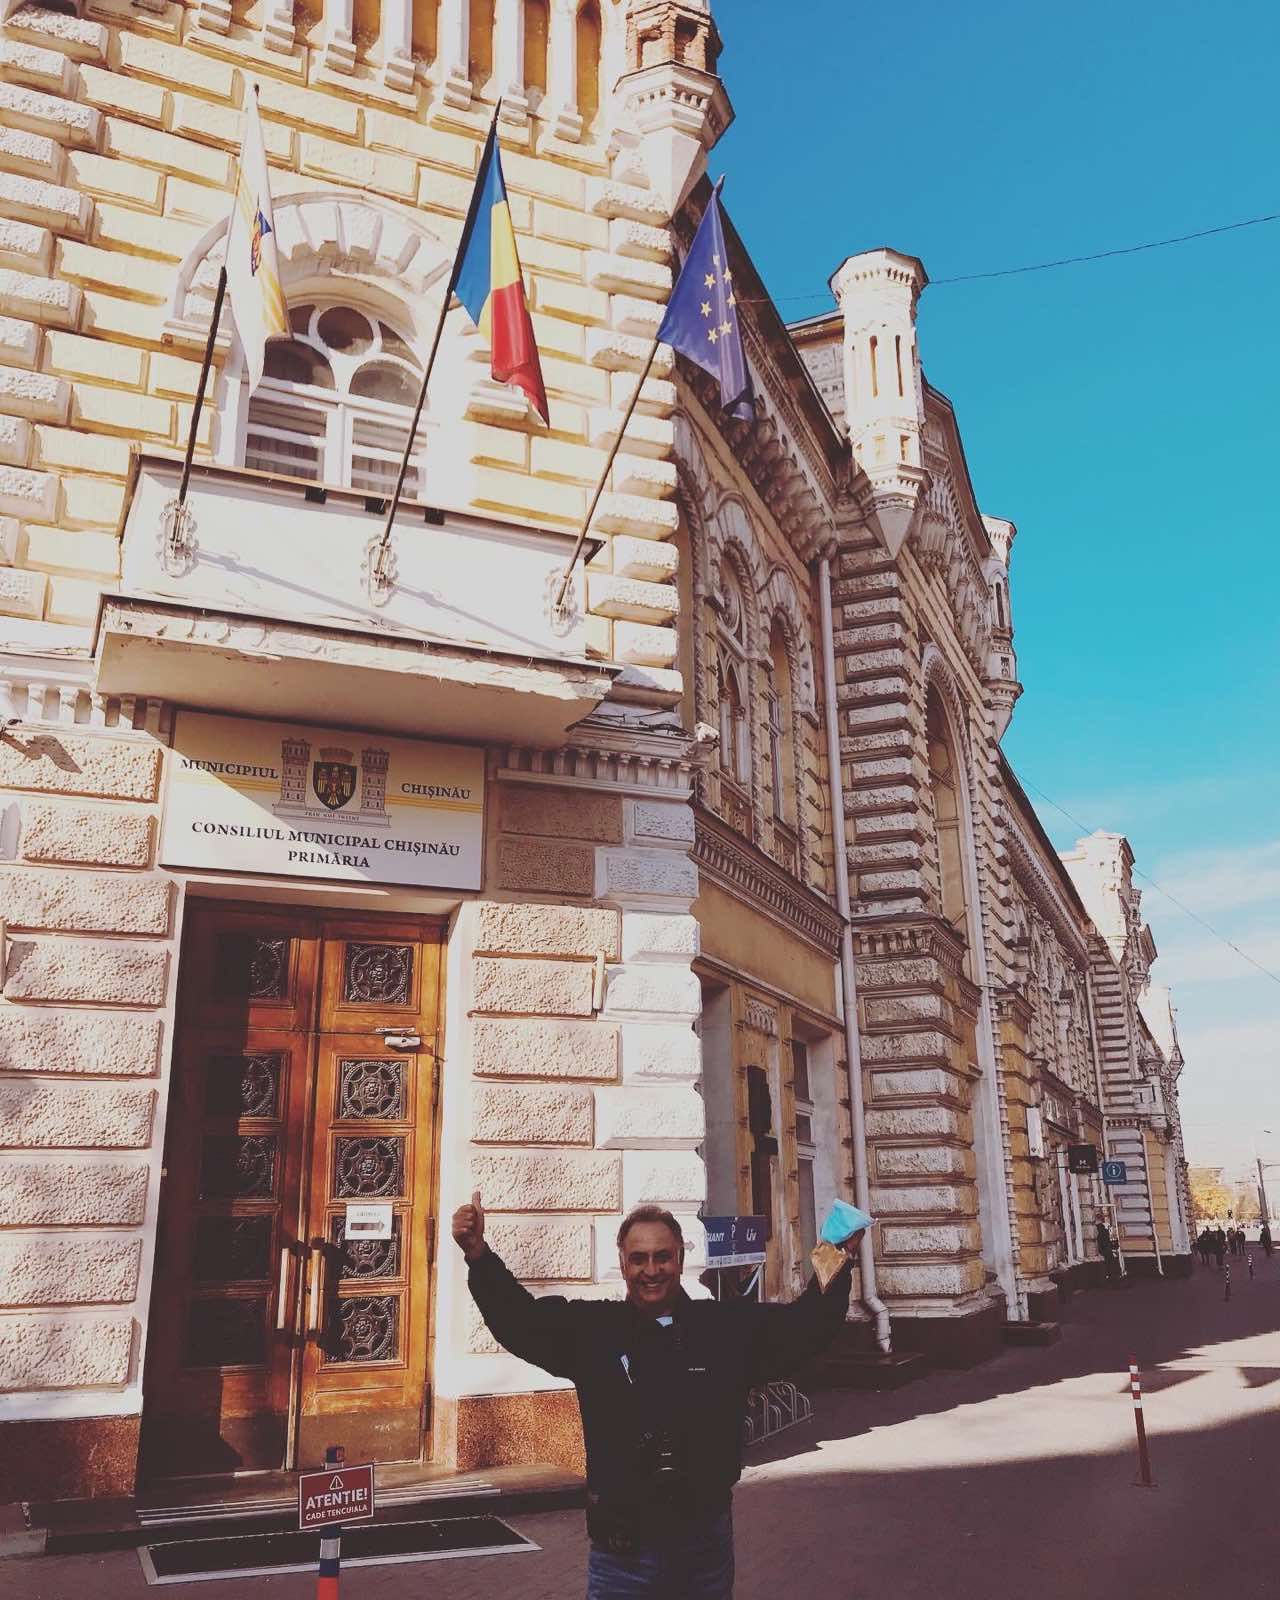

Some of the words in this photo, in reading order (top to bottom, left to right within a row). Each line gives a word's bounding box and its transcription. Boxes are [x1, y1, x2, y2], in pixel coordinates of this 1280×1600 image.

[181, 759, 279, 779] MUNICIPIUL
[401, 783, 471, 800] CHIȘINĂU
[191, 821, 285, 840] CONSILIUL
[287, 830, 381, 849] MUNICIPAL
[384, 839, 460, 856] CHIȘINĂU
[287, 851, 370, 868] PRIMĂRIA
[305, 1512, 326, 1521] CADE
[327, 1504, 368, 1517] TENCUIALA
